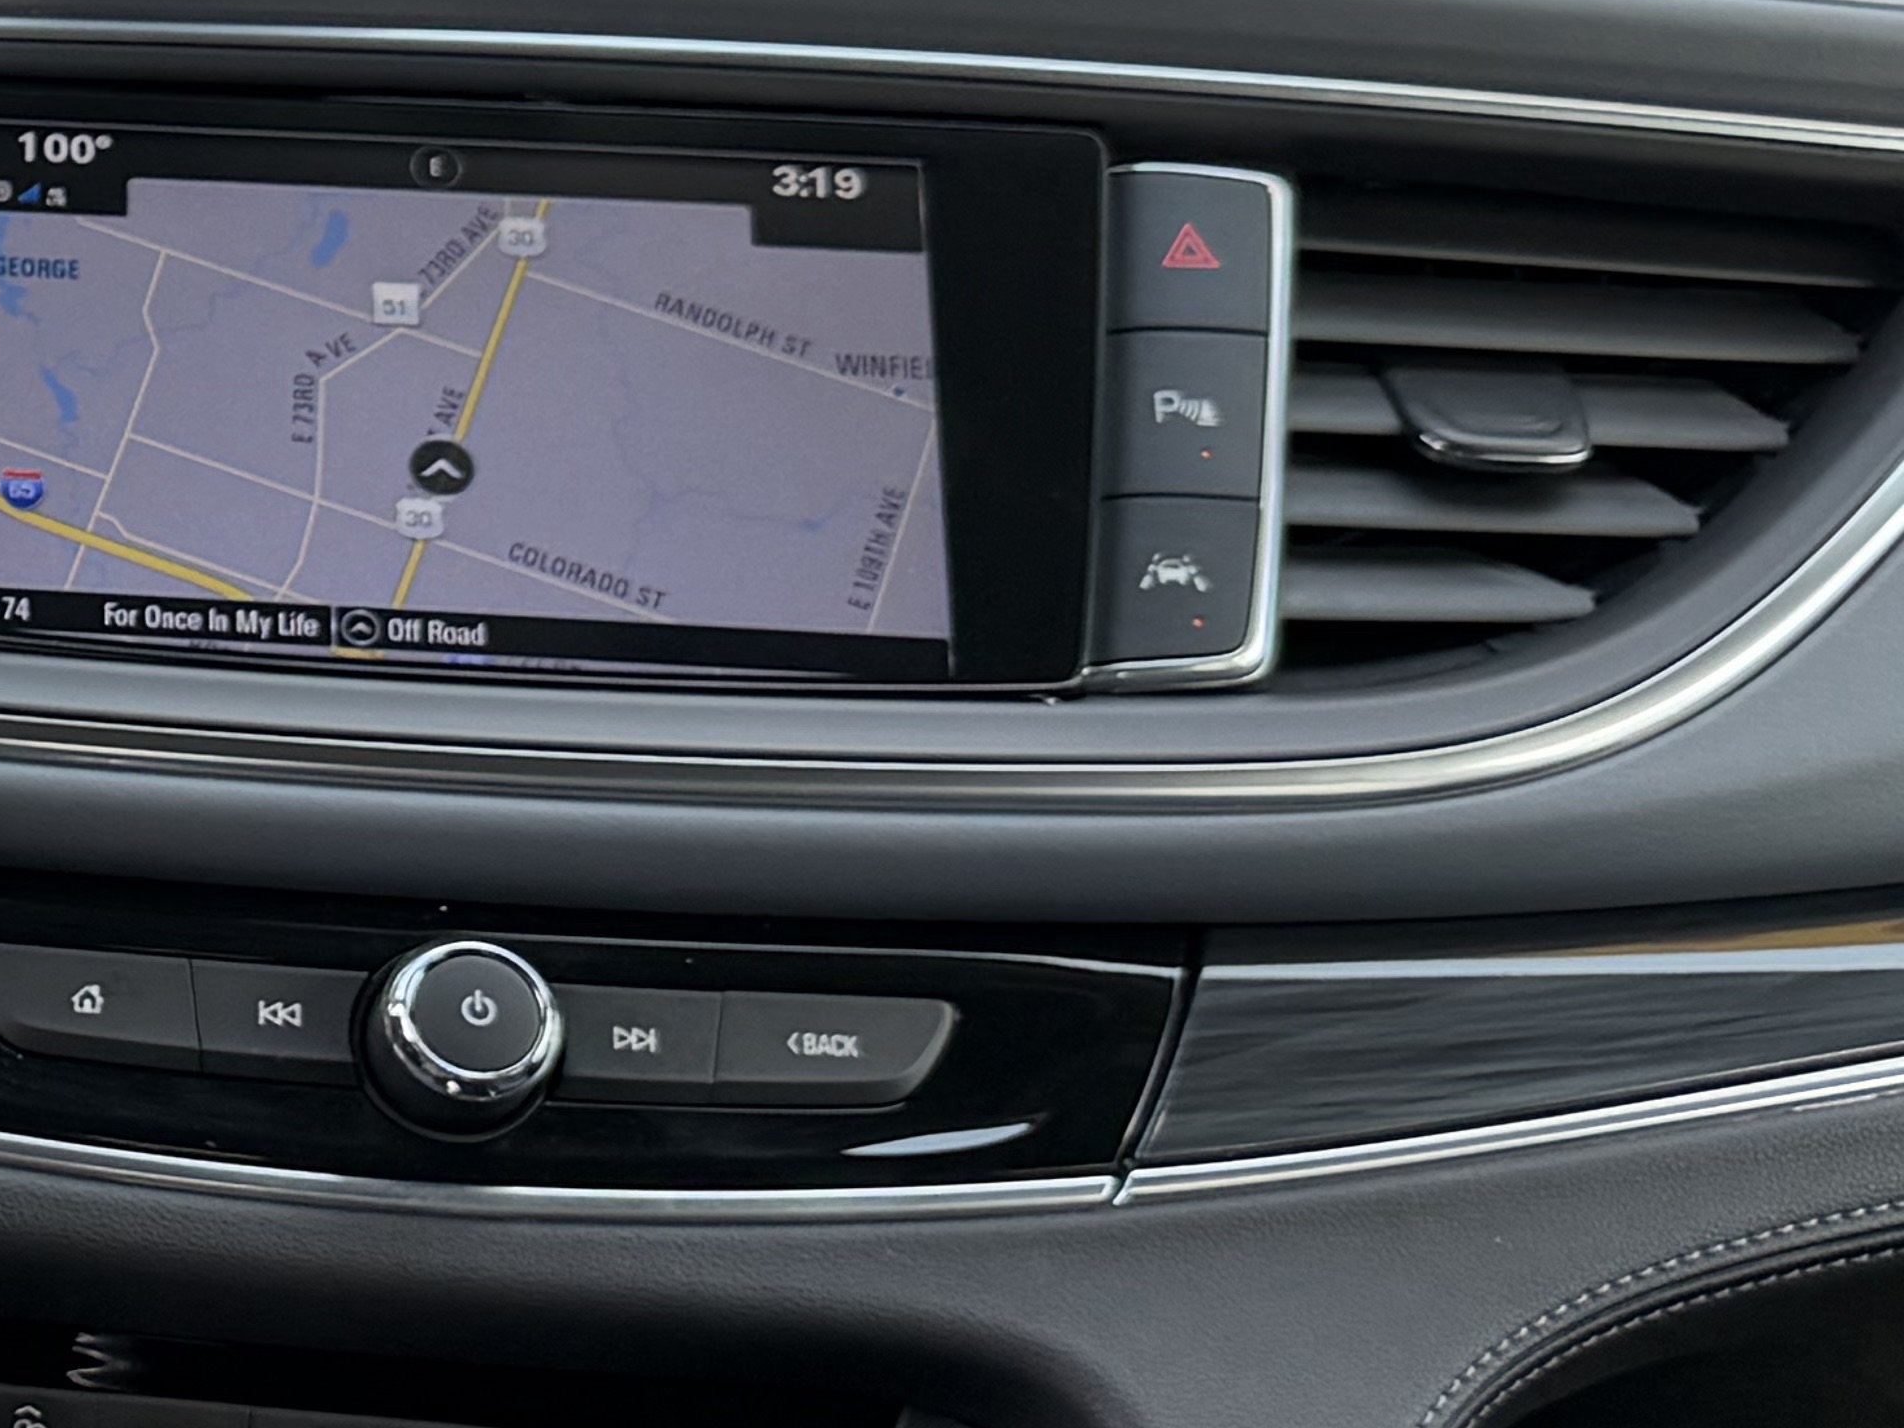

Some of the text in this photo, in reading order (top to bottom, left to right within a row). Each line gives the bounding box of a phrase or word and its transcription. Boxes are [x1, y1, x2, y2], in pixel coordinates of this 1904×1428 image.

[772, 164, 865, 200] 3:19
[461, 205, 498, 245] AVE
[654, 291, 812, 359] RANDOLPH ST
[305, 332, 356, 367] AVE
[508, 542, 667, 610] COLORADO ST
[1, 596, 31, 621] 74
[104, 602, 320, 639] For Once In My Life
[388, 618, 488, 646] Off Road
